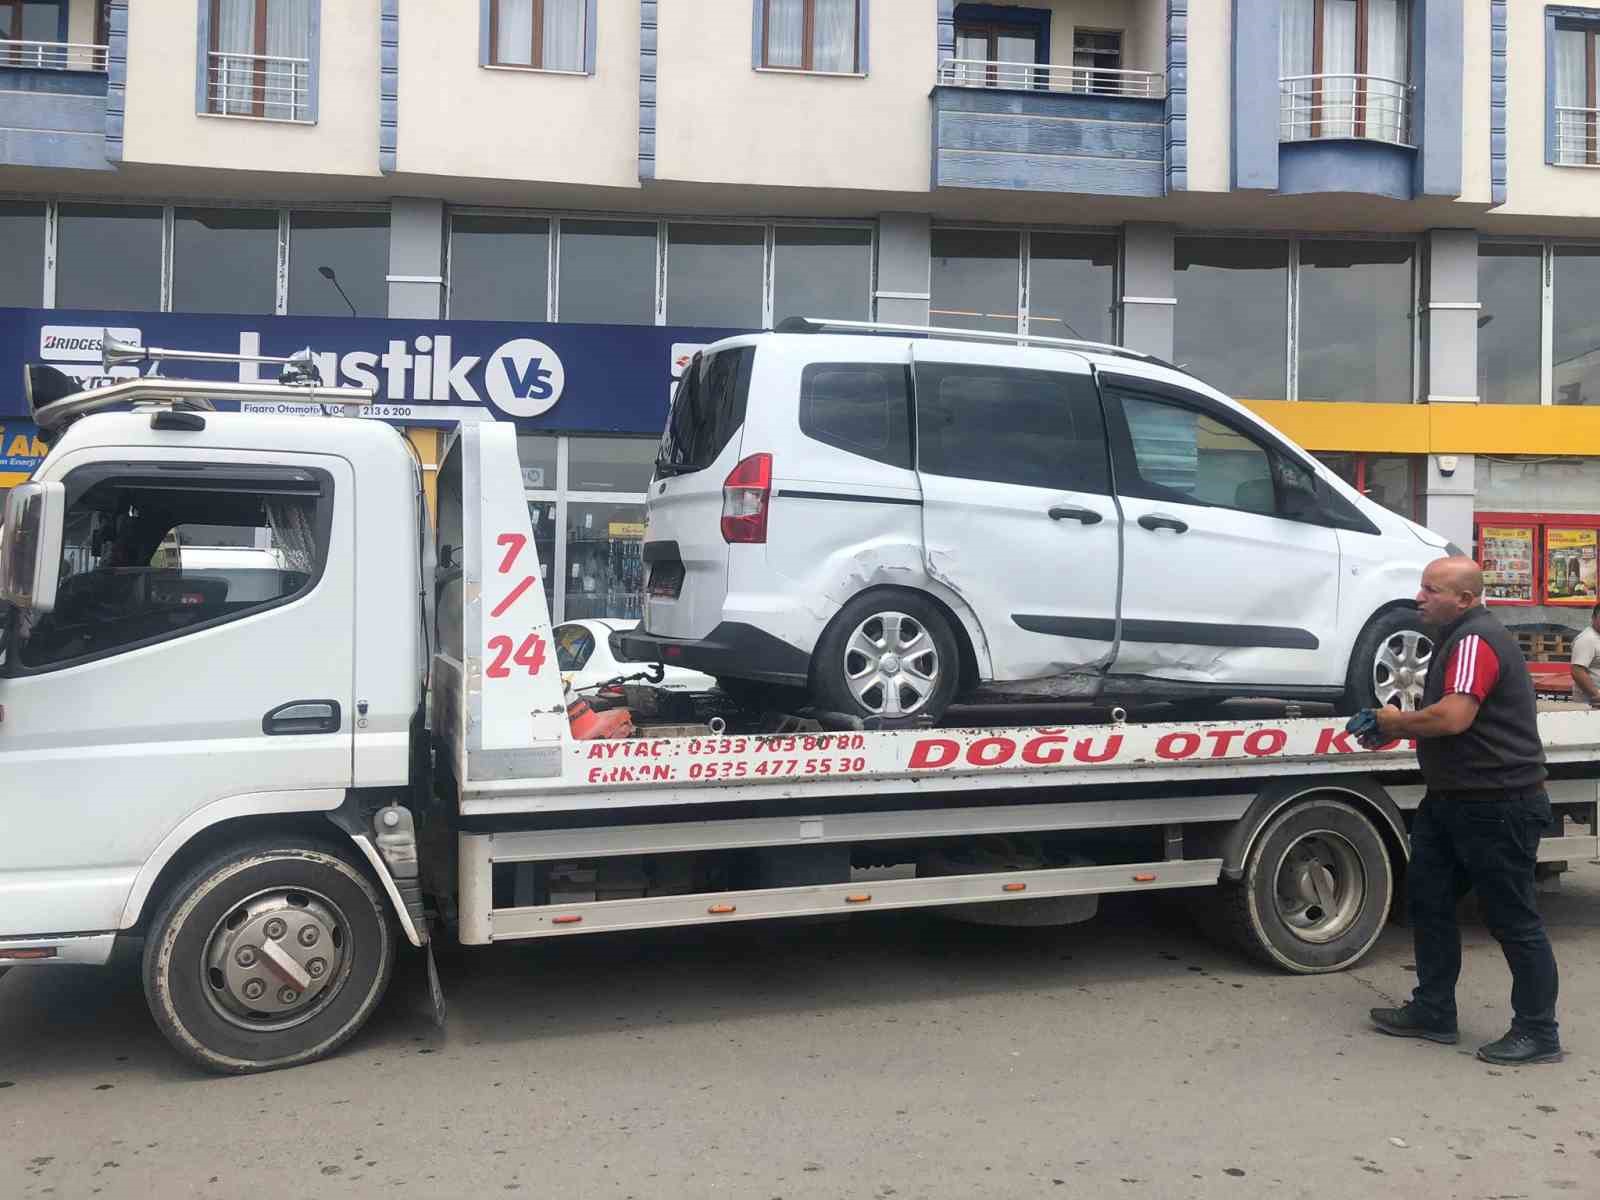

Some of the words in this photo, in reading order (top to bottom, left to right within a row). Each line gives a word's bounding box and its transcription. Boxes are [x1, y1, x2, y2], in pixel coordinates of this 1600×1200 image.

[44, 336, 137, 351] BRIDGES
[239, 331, 481, 402] Lastik
[363, 406, 380, 416] 213
[383, 407, 390, 416] 6
[392, 407, 411, 417] 200
[496, 533, 527, 574] 7
[486, 633, 546, 678] 24
[688, 738, 748, 755] 0533
[837, 734, 864, 750] 80
[907, 728, 1124, 769] DOĞU
[1155, 728, 1287, 759] OTO
[754, 757, 798, 776] 477
[804, 758, 833, 773] 55
[838, 757, 865, 772] 30
